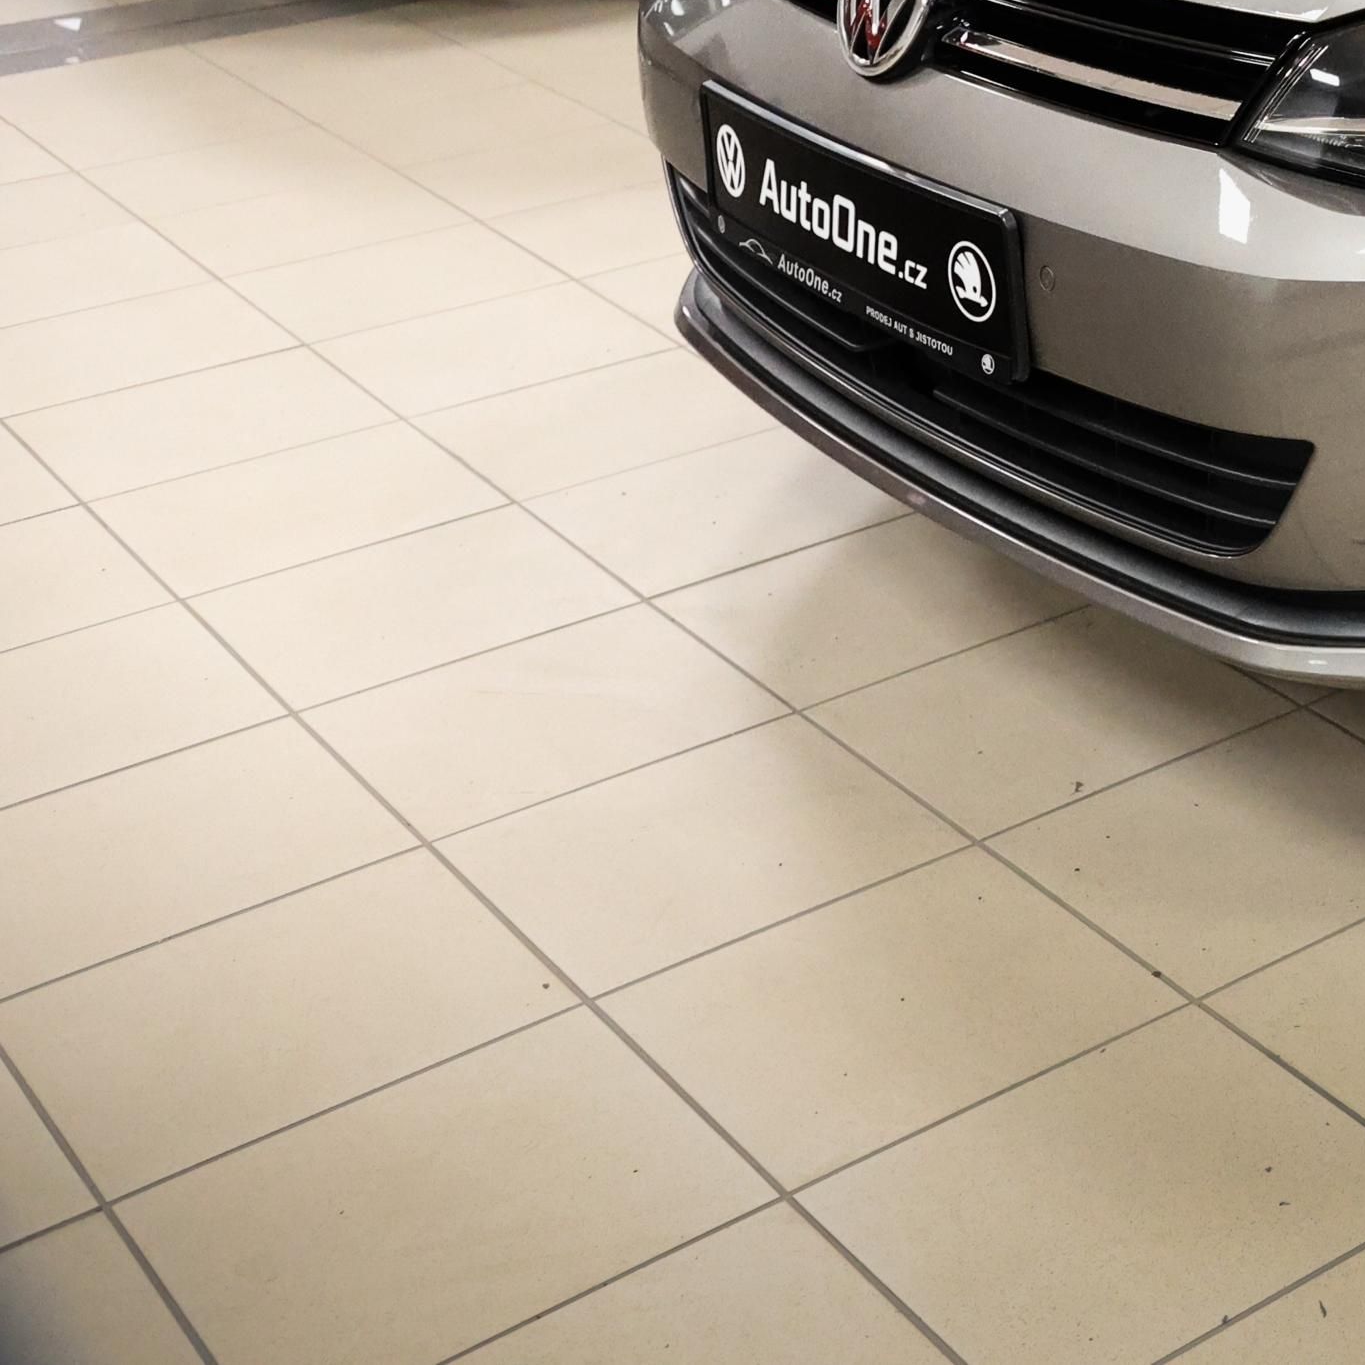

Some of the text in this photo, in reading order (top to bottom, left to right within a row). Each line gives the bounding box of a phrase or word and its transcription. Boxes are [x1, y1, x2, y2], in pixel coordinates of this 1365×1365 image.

[758, 159, 928, 290] AutoOne.cz
[778, 254, 843, 303] AutoOne.cz
[865, 305, 892, 327] PRODEJ
[893, 320, 908, 335] AUT
[915, 331, 953, 356] JISTOTOU
